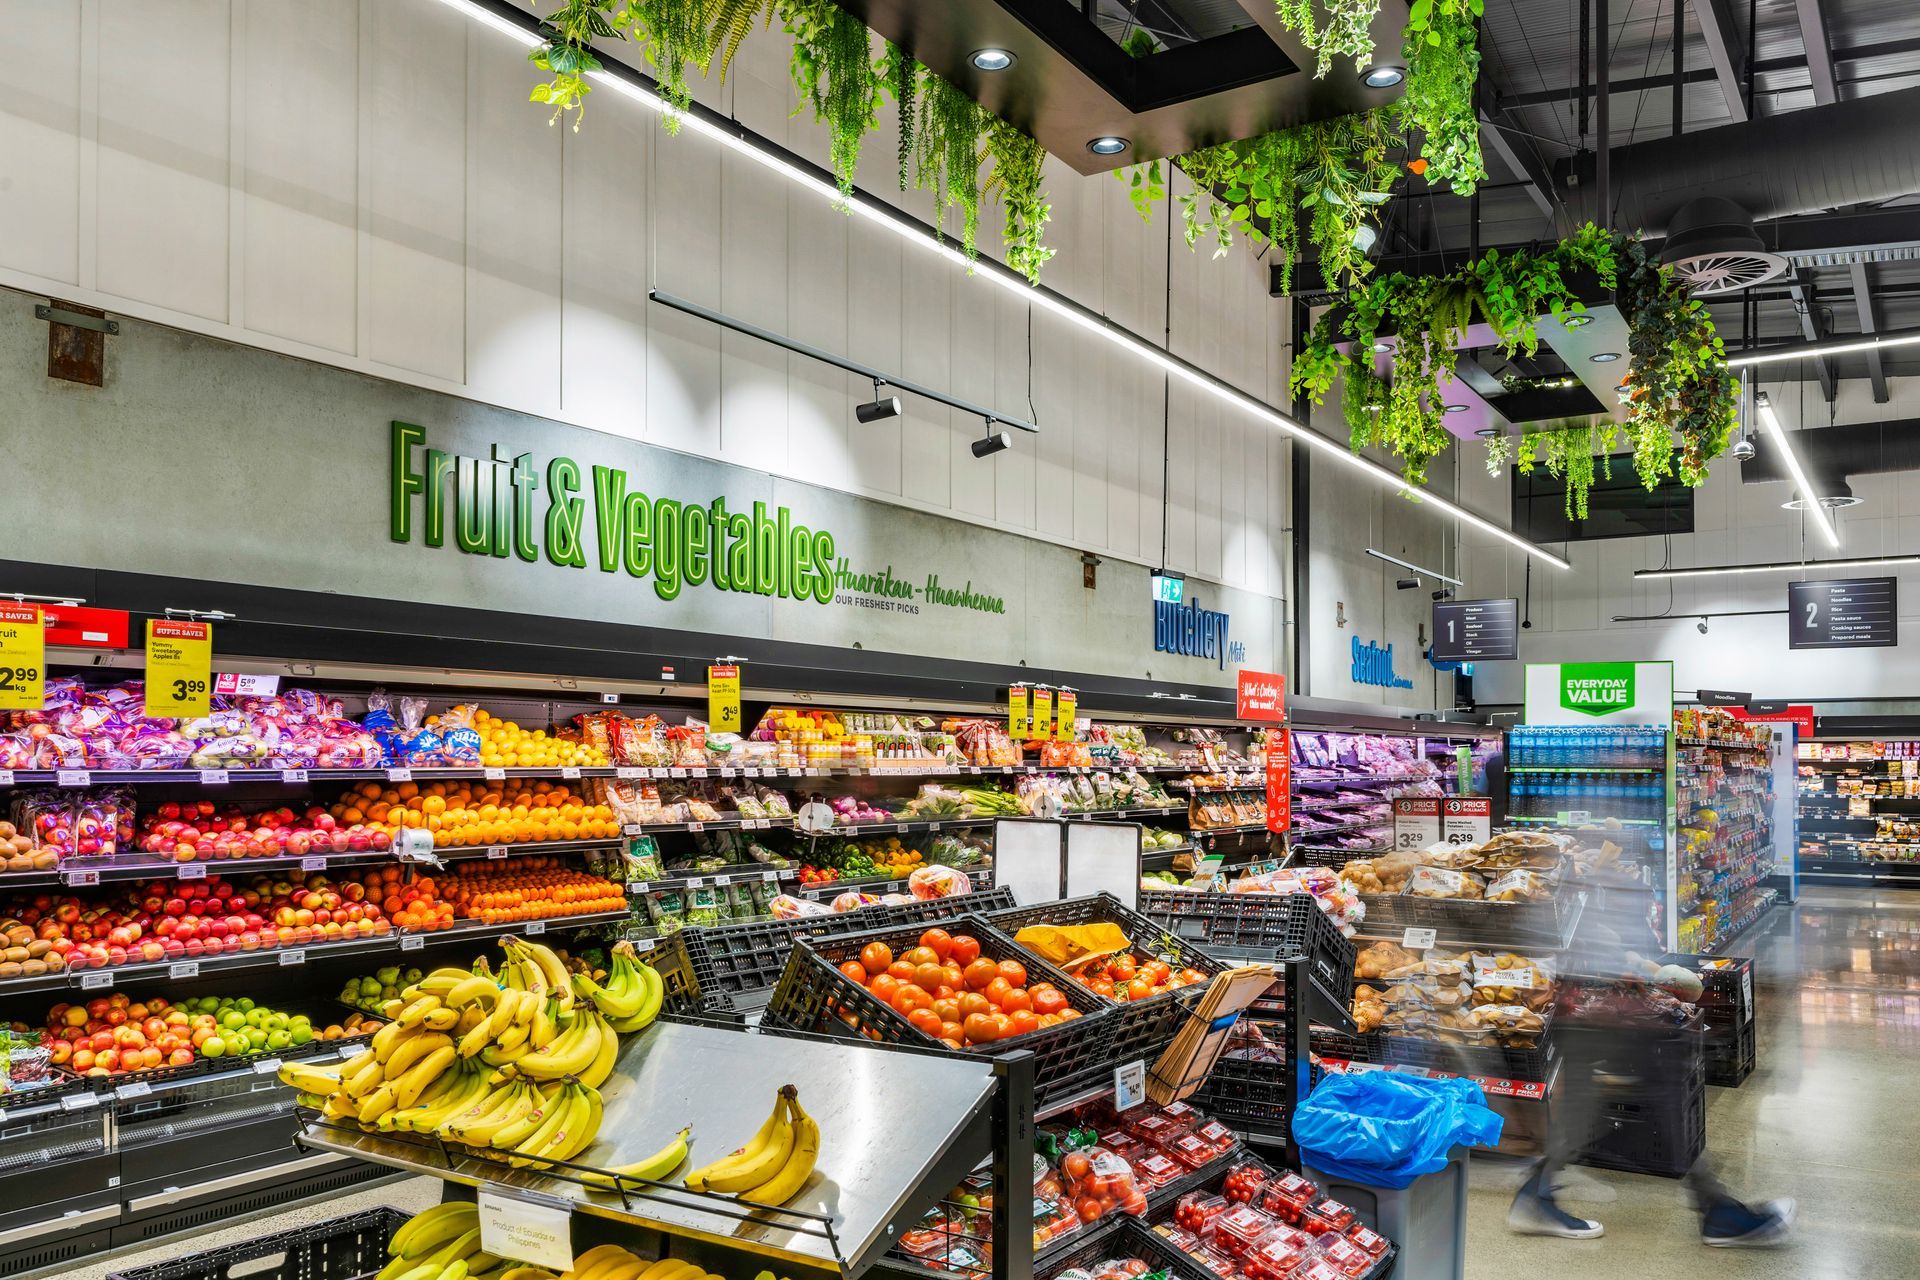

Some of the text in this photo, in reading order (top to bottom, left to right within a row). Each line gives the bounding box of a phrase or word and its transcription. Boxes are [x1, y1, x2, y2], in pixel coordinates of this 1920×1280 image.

[391, 420, 835, 605] Fruit & Vegetables
[835, 594, 920, 615] OUR FRESHEST PICKS
[6, 612, 33, 620] SAVER
[1806, 602, 1818, 628] 2
[156, 627, 204, 637] SUPER SAVER
[1155, 597, 1231, 671] Butchery
[1447, 620, 1455, 643] 1
[1352, 635, 1393, 688] Seafood
[15, 684, 26, 692] kg
[1566, 679, 1628, 689] EVERYDAY
[1567, 689, 1628, 703] VALUE
[1249, 699, 1275, 710] this week?
[493, 1219, 515, 1232] Product
[508, 1234, 541, 1249] Philippines
